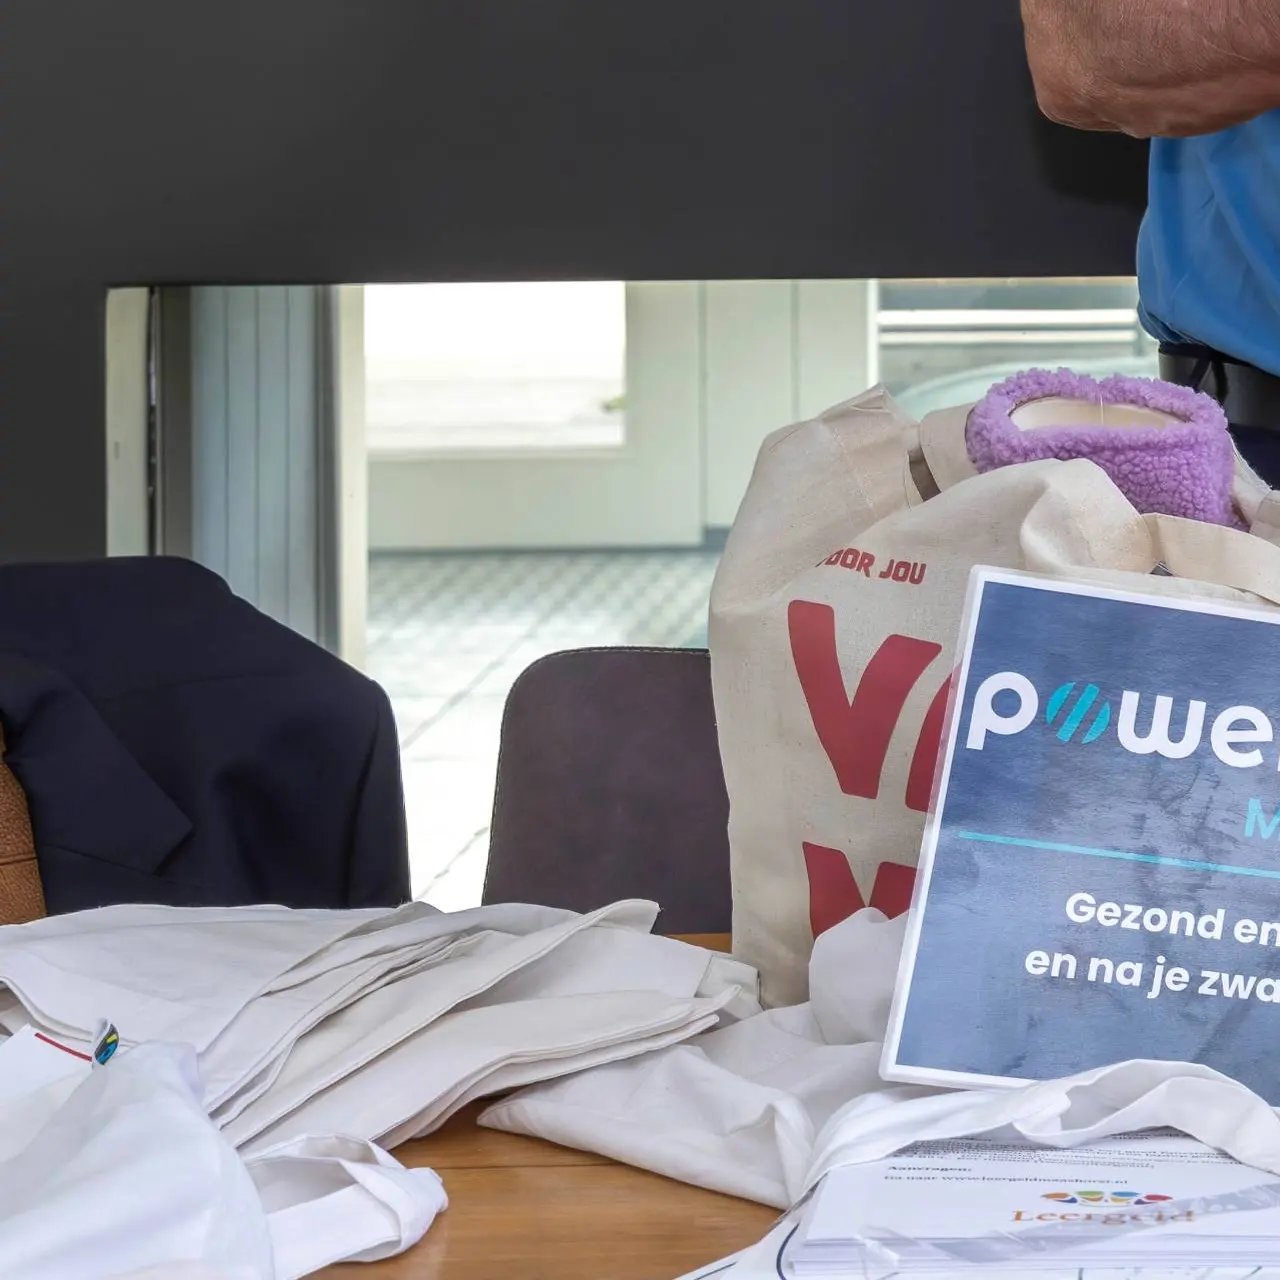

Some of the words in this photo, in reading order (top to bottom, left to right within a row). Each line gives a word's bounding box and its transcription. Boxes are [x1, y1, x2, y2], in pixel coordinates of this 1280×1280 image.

[878, 557, 926, 585] JOU
[1065, 892, 1227, 945] Gezond
[1024, 949, 1077, 982] en
[1086, 954, 1143, 989] na
[1147, 957, 1190, 999] je
[1011, 1210, 1196, 1225] Leergeld
